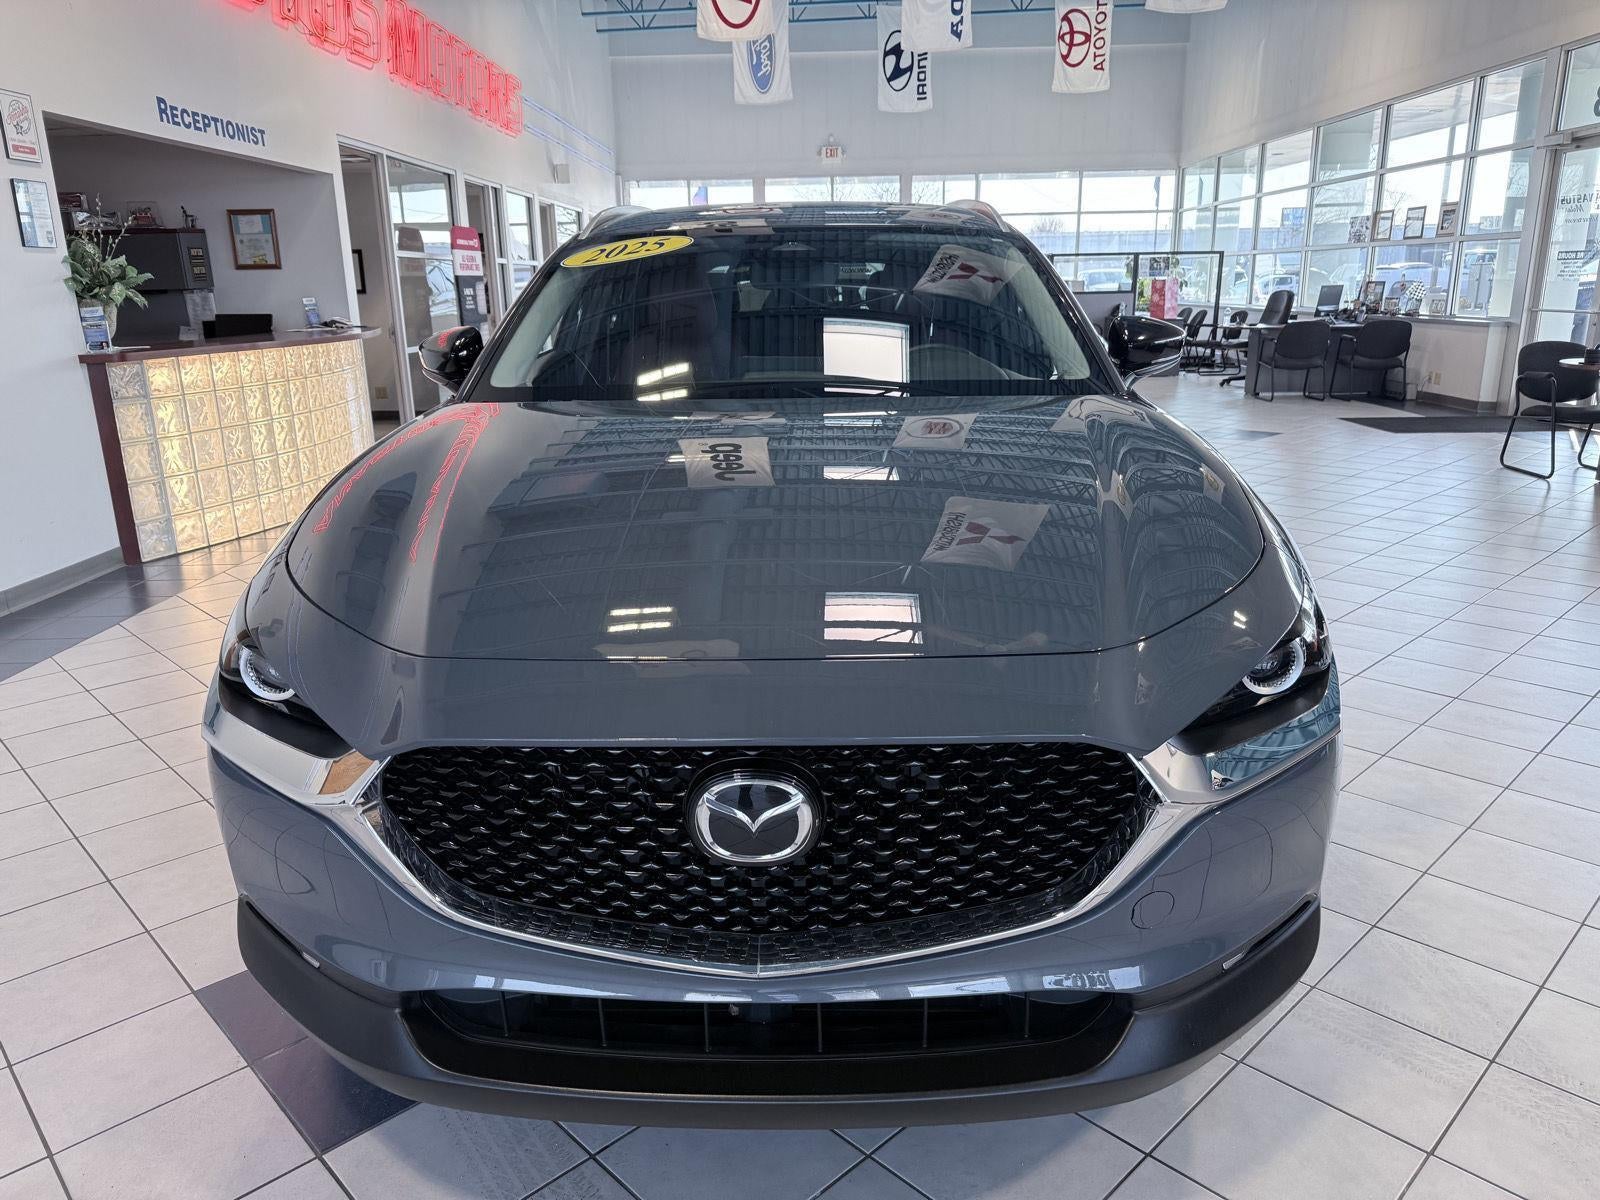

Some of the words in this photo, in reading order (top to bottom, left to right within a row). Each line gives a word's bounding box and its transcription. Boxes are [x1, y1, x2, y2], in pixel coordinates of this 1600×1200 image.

[387, 0, 523, 137] MOTORS
[155, 95, 266, 148] RECEPTIONIST
[825, 148, 839, 158] EXIT
[582, 238, 671, 264] 2025
